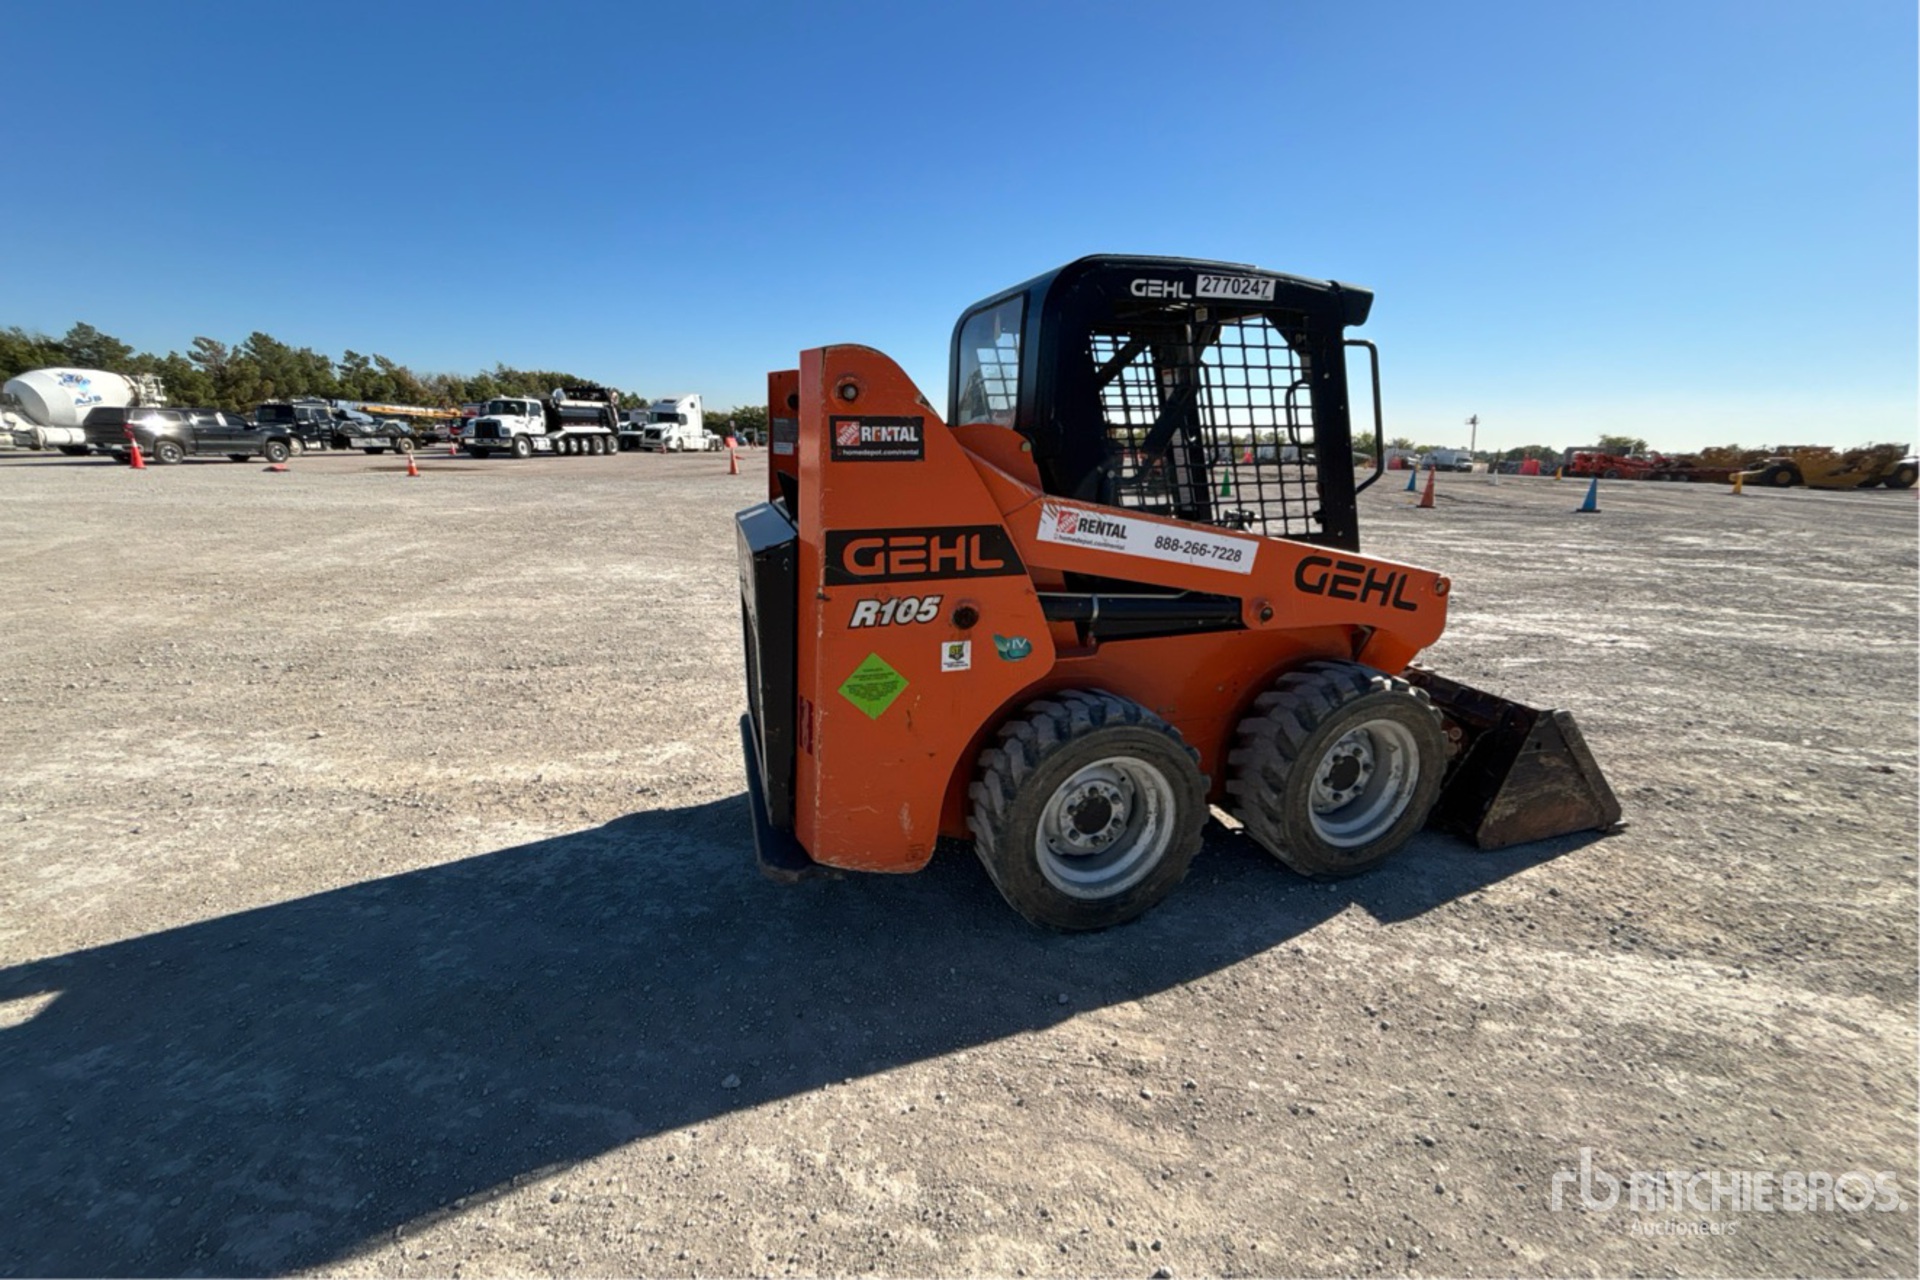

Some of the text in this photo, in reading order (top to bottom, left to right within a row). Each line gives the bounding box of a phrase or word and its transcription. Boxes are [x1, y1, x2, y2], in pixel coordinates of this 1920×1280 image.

[1130, 278, 1192, 299] GEHL
[1201, 276, 1270, 296] 2770247
[861, 426, 919, 442] RENTAL
[1078, 518, 1127, 539] RENTAL
[843, 533, 1004, 576] GEHL
[1155, 535, 1242, 563] 888-266-7228
[1294, 555, 1418, 612] GEHL
[848, 595, 943, 629] R105
